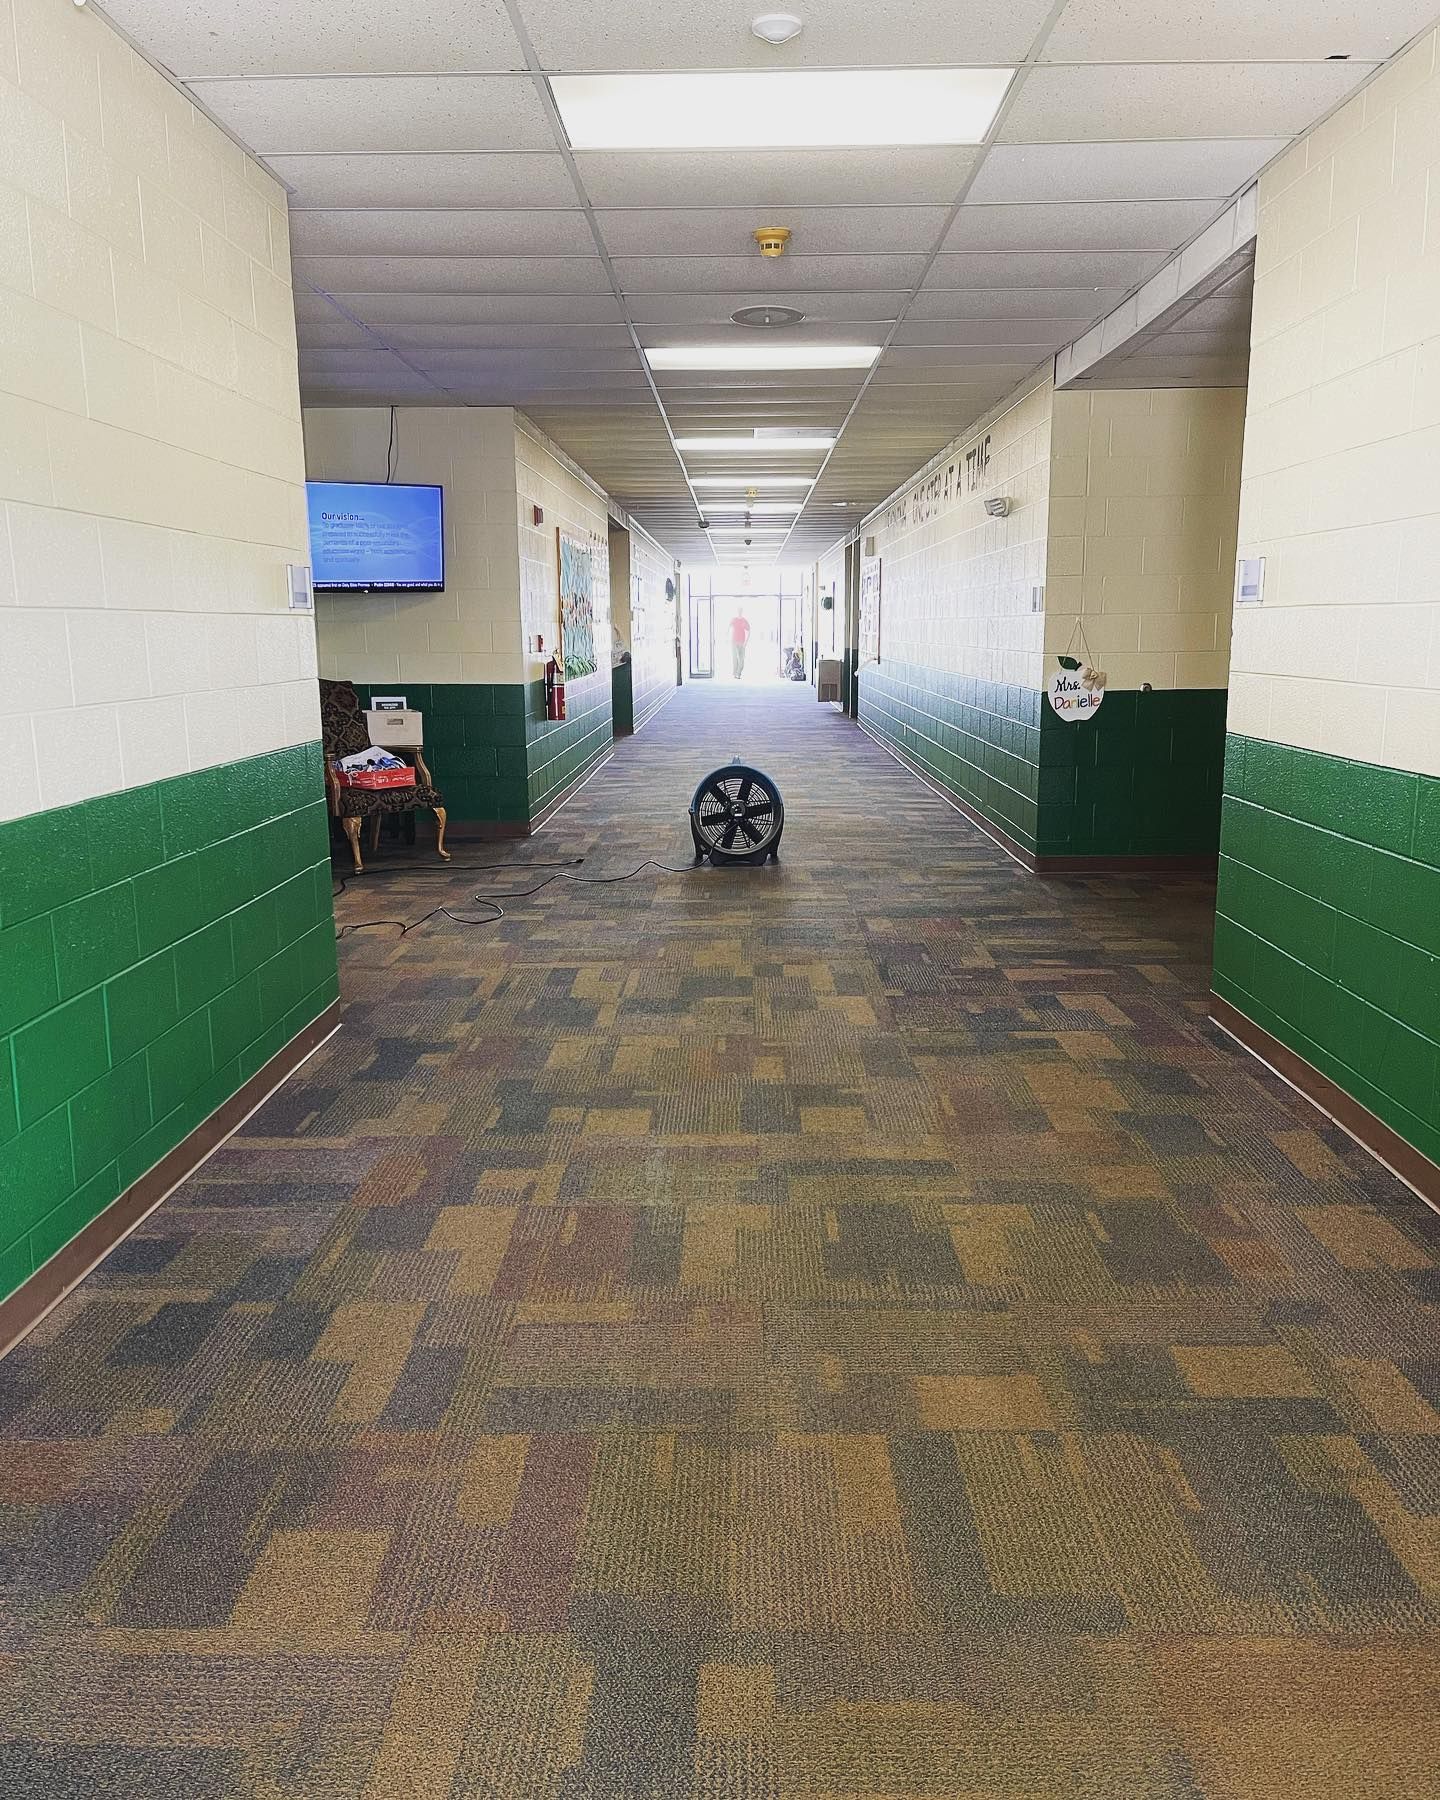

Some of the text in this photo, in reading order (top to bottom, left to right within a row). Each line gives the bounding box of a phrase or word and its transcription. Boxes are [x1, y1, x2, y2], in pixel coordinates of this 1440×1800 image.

[944, 465, 954, 503] AT
[956, 460, 961, 497] A
[965, 435, 991, 491] TIME
[322, 512, 336, 520] Our
[1054, 676, 1080, 693] Mrs.
[1054, 693, 1100, 710] Danielle
